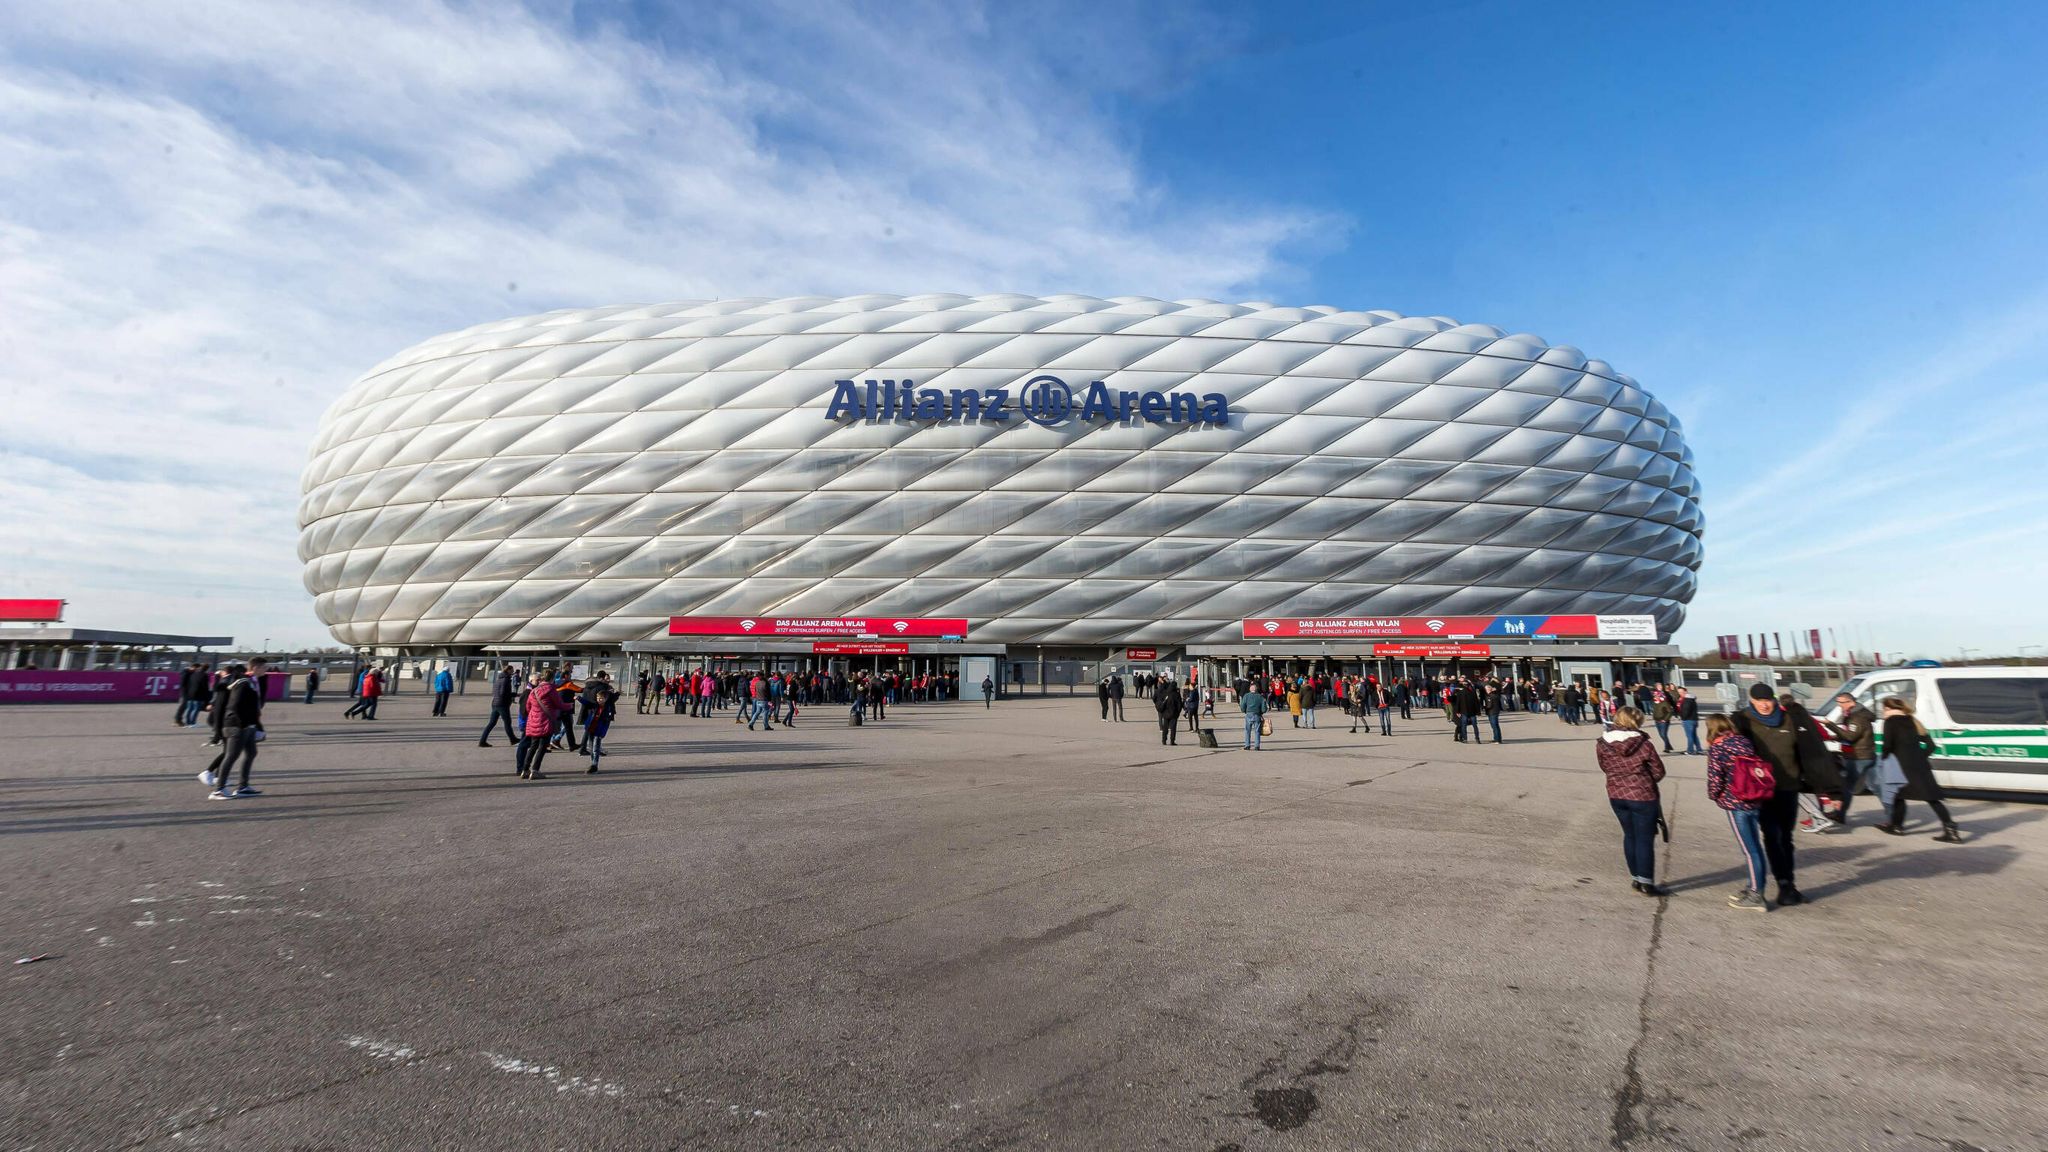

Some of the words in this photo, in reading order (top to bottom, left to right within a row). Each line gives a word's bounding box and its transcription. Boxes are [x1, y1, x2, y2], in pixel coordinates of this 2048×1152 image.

[825, 379, 1009, 420] Allianz
[1081, 380, 1229, 424] Arena
[776, 619, 790, 627] DAS
[791, 619, 820, 628] ALLIANZ
[820, 620, 844, 628] ARENA
[845, 620, 866, 628] WLAN
[1299, 620, 1314, 628] DAS
[1315, 620, 1347, 628] ALLIANZ
[16, 683, 44, 691] WAS
[47, 683, 117, 691] VERBINDET.
[145, 676, 168, 696] T
[1967, 746, 2029, 756] POLIZEI
